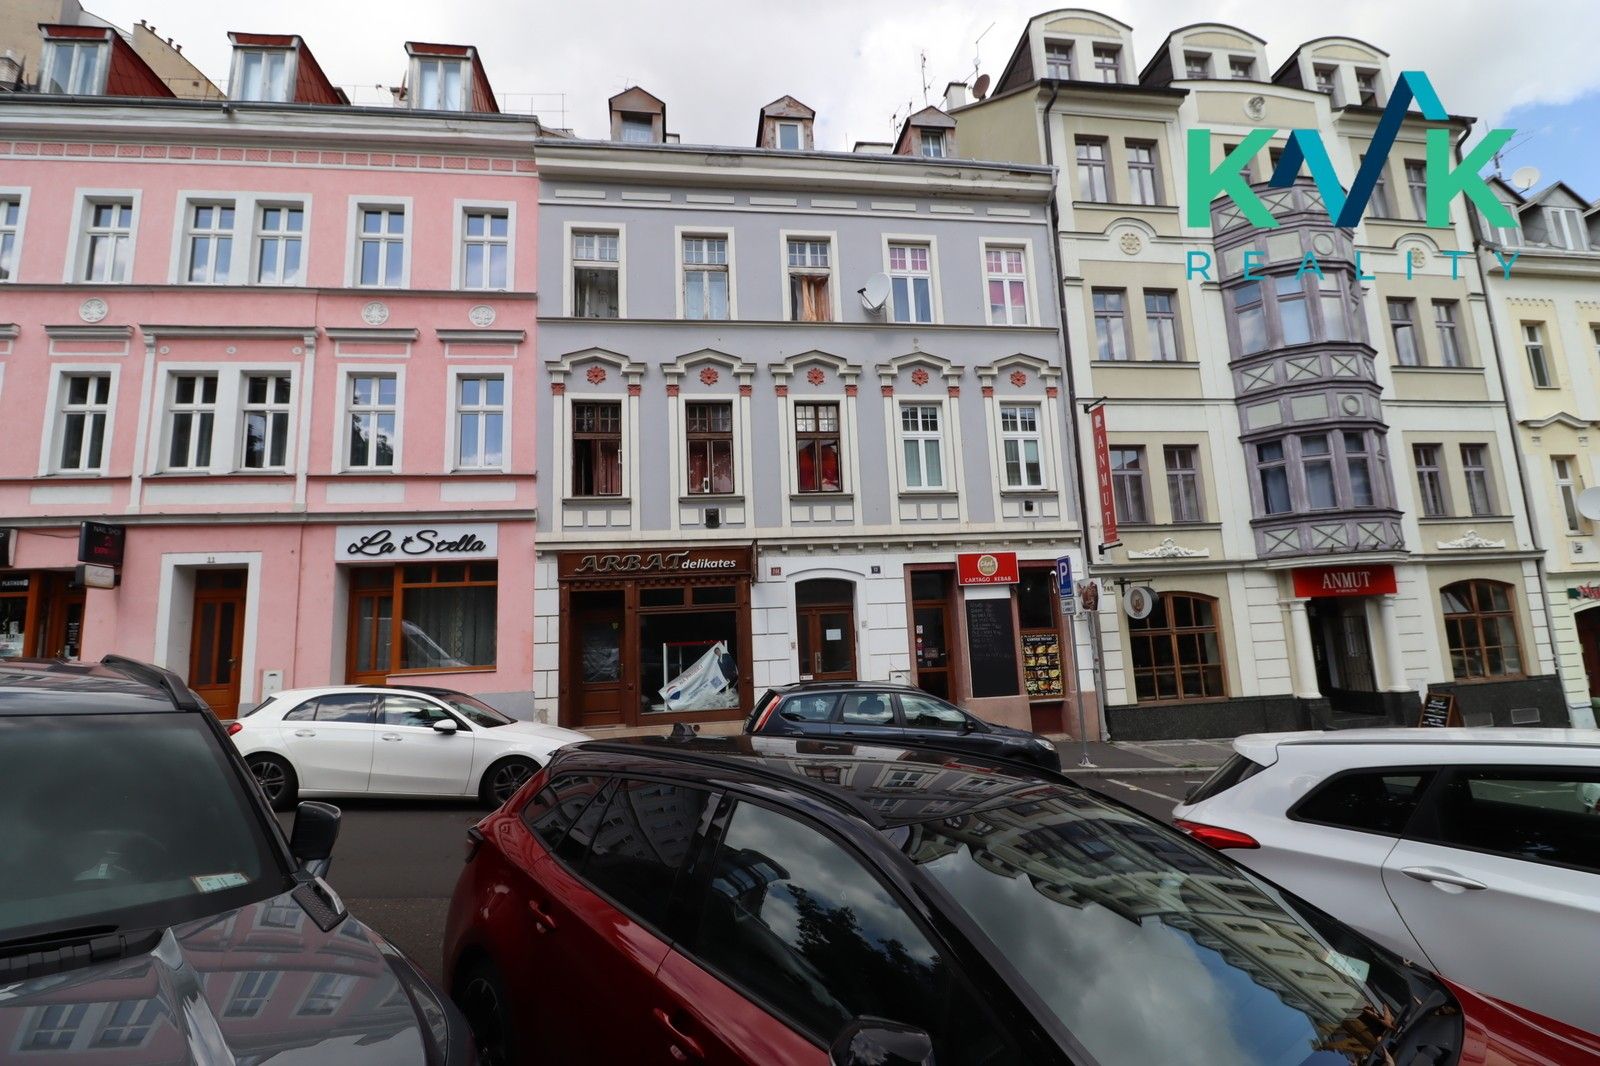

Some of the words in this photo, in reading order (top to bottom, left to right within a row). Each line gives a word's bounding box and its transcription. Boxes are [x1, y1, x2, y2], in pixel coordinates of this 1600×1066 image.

[1098, 435, 1111, 525] ANMUT
[347, 529, 396, 556] La
[401, 529, 486, 555] Stella
[575, 551, 689, 573] ARBAT
[681, 559, 737, 570] delikates
[1060, 562, 1068, 585] P
[1322, 571, 1371, 589] ANMUT
